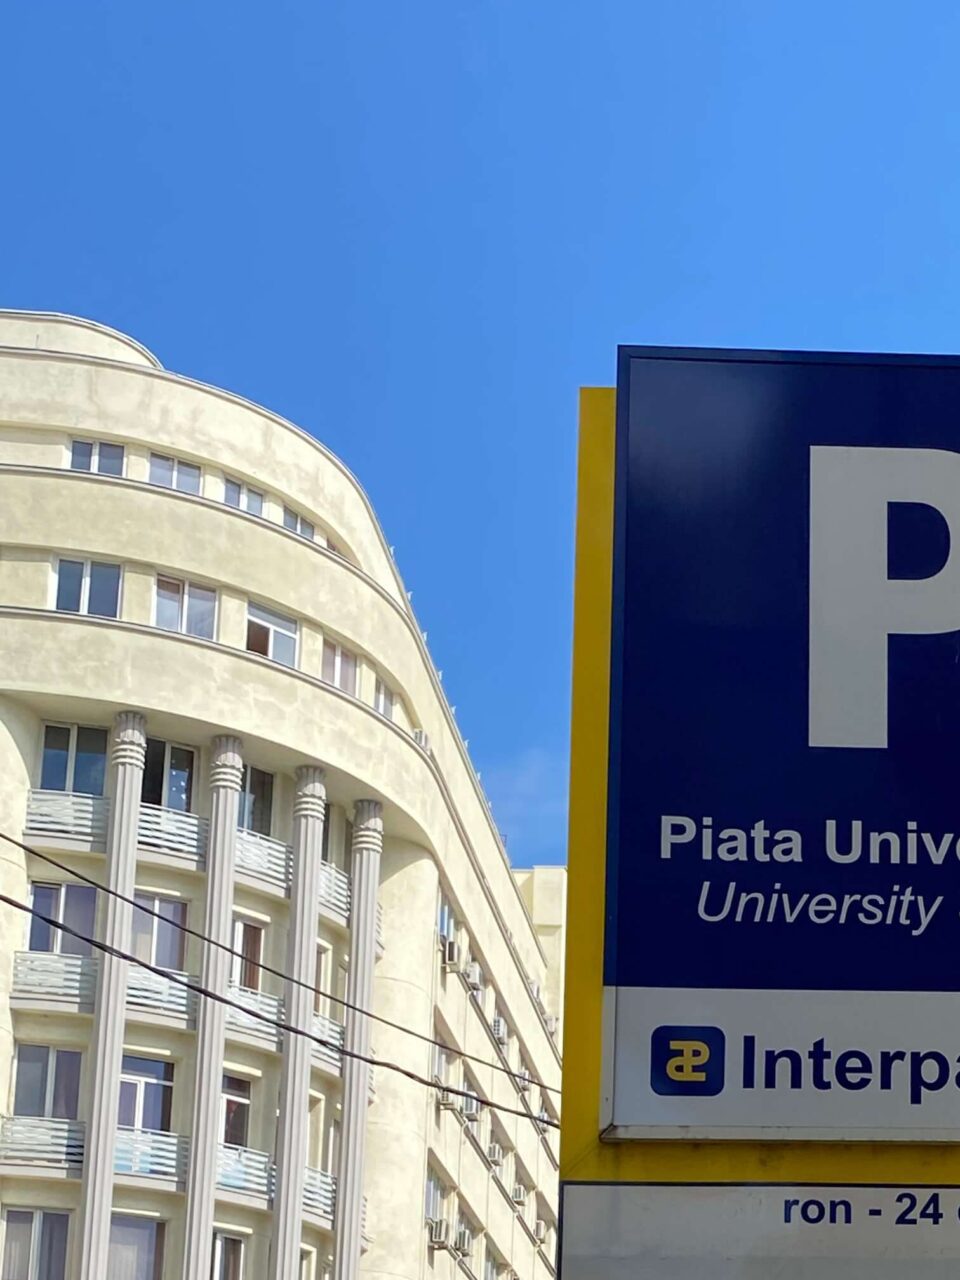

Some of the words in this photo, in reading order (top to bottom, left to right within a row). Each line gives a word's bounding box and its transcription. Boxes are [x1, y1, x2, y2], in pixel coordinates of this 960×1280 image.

[659, 815, 802, 863] Piata
[697, 881, 942, 936] University
[784, 1196, 852, 1224] ron
[894, 1193, 943, 1226] 24
